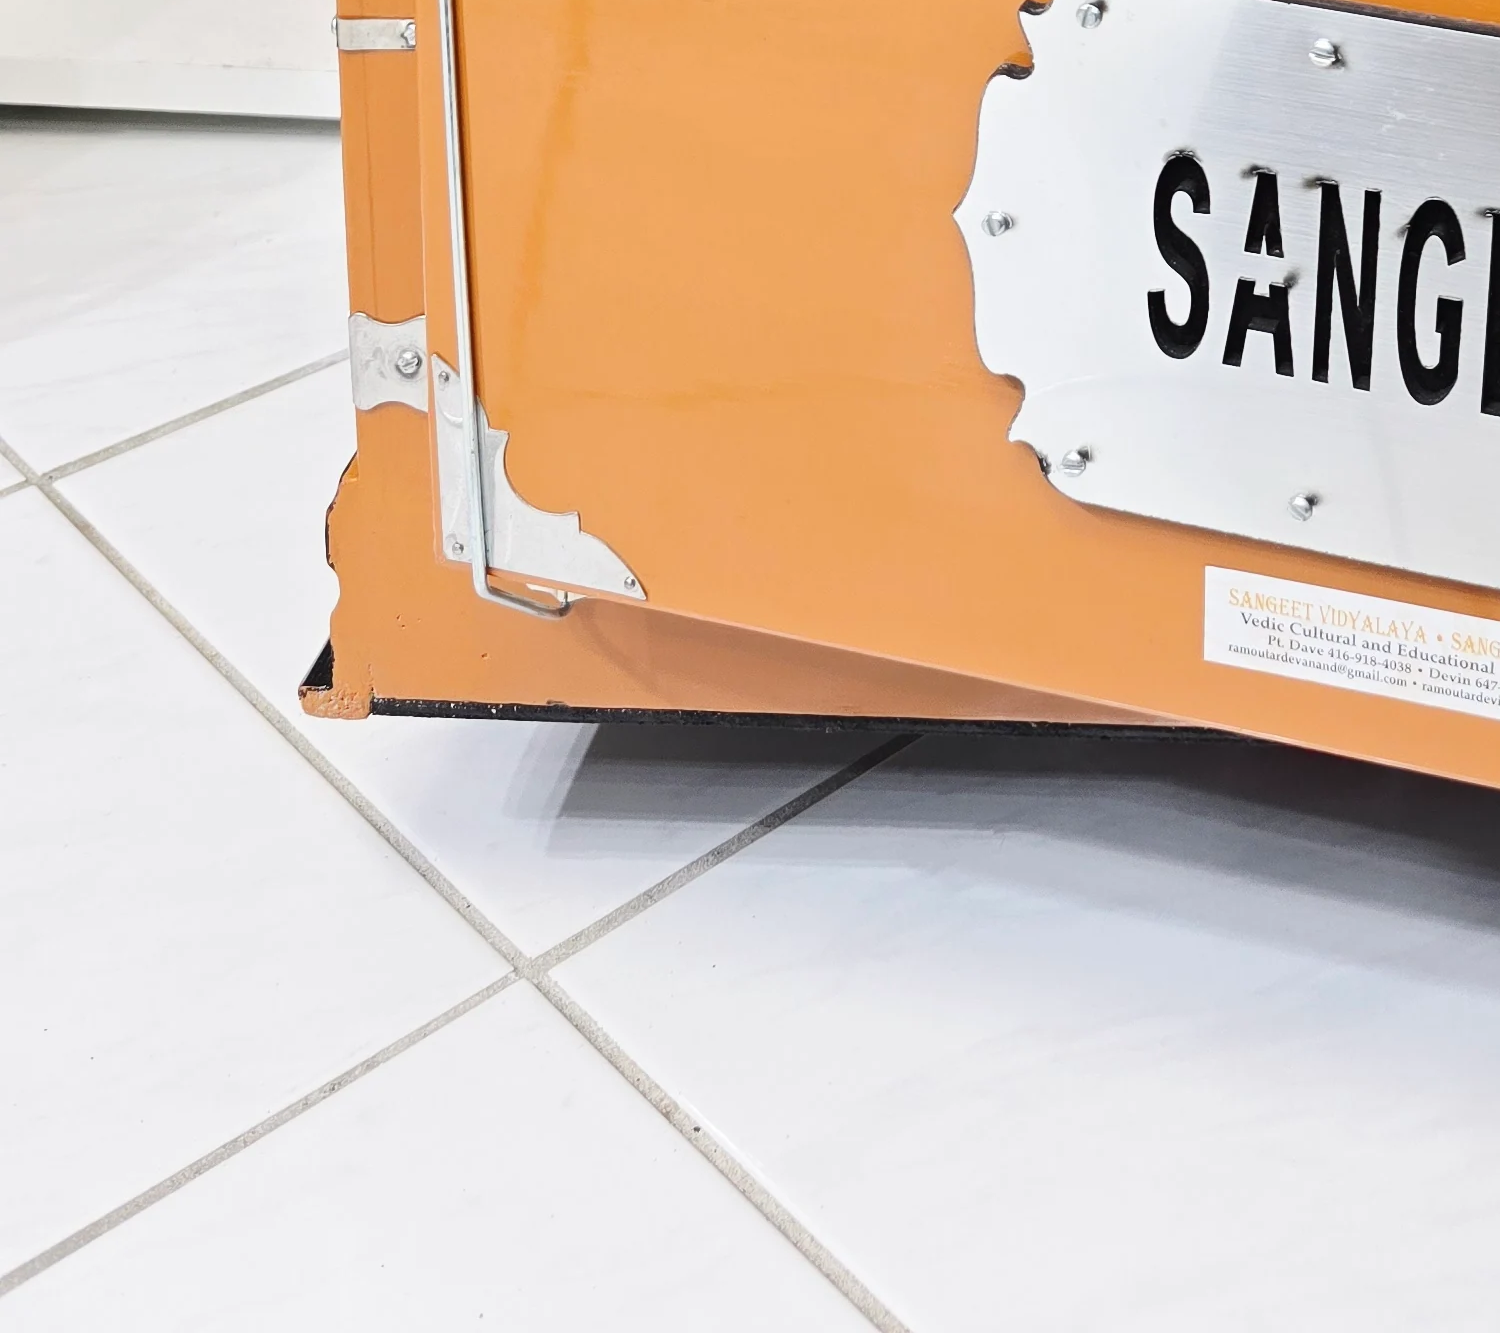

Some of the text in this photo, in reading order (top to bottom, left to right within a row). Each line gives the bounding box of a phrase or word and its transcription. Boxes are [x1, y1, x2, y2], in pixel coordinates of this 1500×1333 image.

[1228, 587, 1314, 621] SANGEET
[1319, 604, 1427, 644] VIDYALAYA
[1240, 612, 1285, 633] Vedic
[1290, 621, 1357, 647] Cultural
[1362, 638, 1391, 654] and
[1398, 645, 1495, 675] Educational
[1268, 635, 1284, 649] Pt.
[1289, 639, 1324, 656] Dave
[1328, 648, 1412, 674] 416-918-4038
[1428, 667, 1471, 686] Devin
